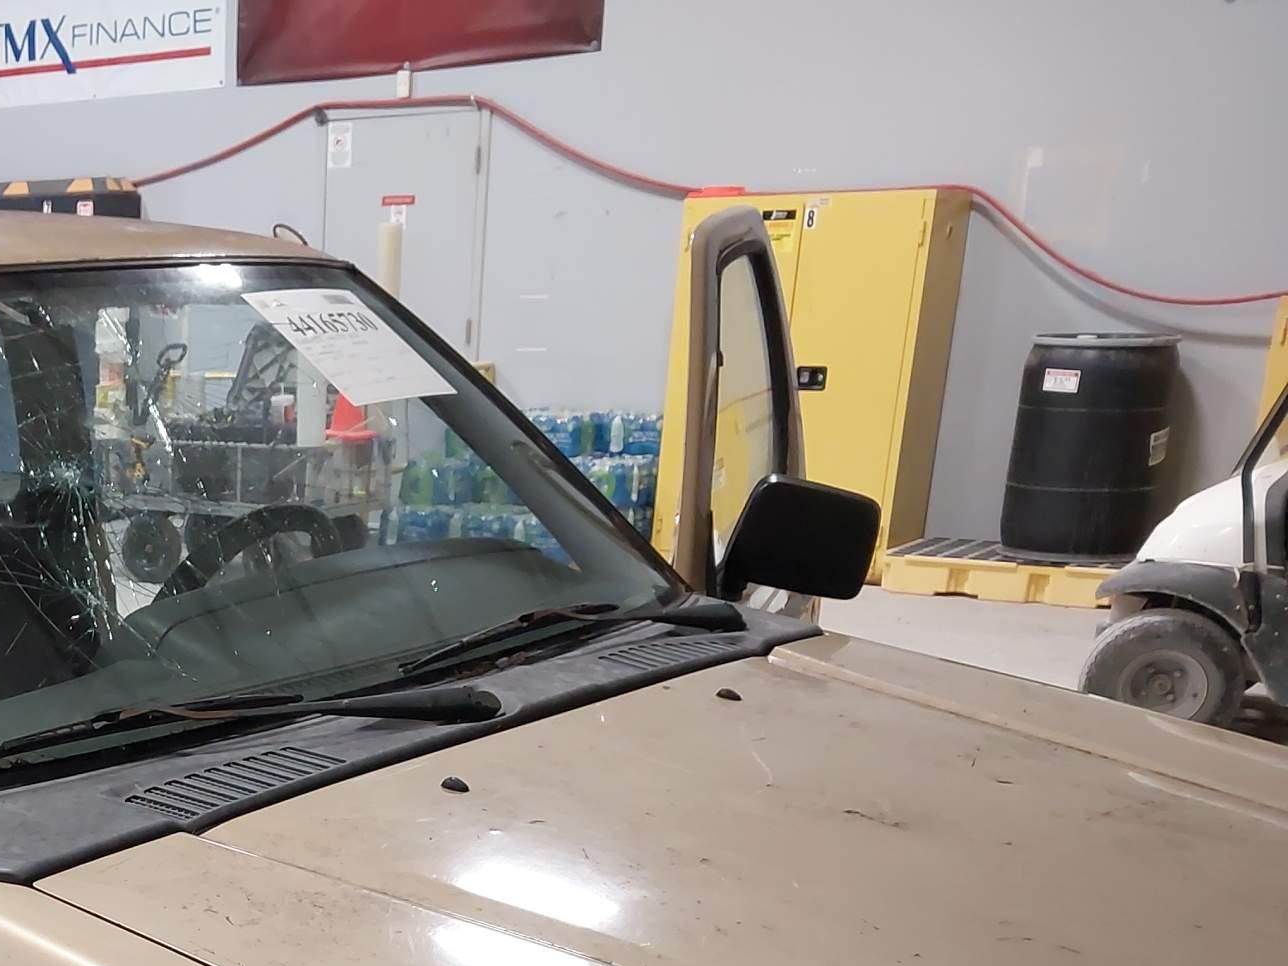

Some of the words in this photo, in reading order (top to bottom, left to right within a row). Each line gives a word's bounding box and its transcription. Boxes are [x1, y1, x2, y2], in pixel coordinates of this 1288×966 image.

[71, 8, 213, 48] FINANCE
[807, 209, 815, 228] 8
[287, 311, 379, 336] 44165730
